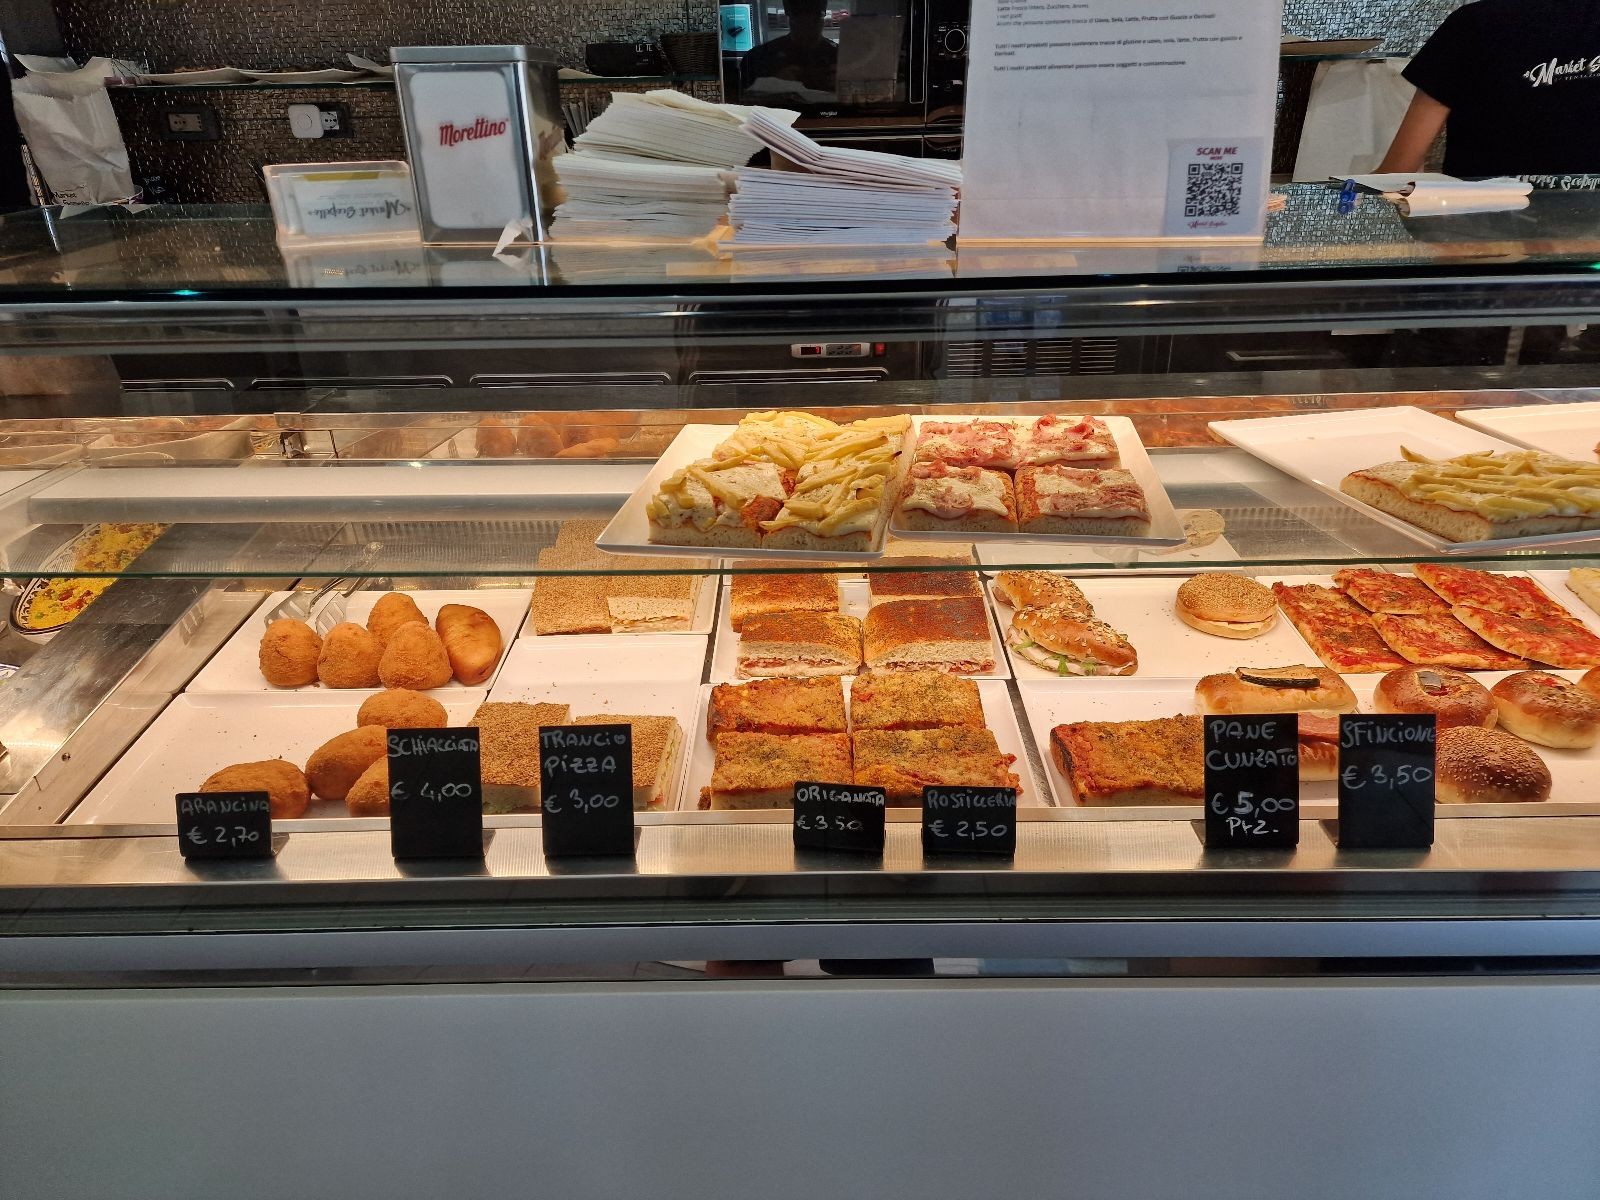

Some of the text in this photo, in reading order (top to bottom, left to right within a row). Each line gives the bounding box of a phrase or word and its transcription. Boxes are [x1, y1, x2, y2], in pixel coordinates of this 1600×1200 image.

[1528, 57, 1587, 88] Market
[439, 117, 507, 147] Morettino
[1196, 146, 1238, 156] SCAN ME
[540, 730, 627, 748] TRANCIO
[1209, 719, 1277, 743] PANE
[1341, 720, 1436, 748] SFINCIONE
[544, 754, 617, 778] PIZZA
[1205, 747, 1297, 771] CUNZATO
[1341, 764, 1433, 790] € 3,50
[391, 781, 472, 802] € 4,00
[544, 788, 620, 814] € 3,00
[181, 796, 270, 816] ARANCINA
[1211, 791, 1296, 818] € 5,00
[186, 826, 260, 848] € 2,70
[928, 819, 1008, 840] € 2,50
